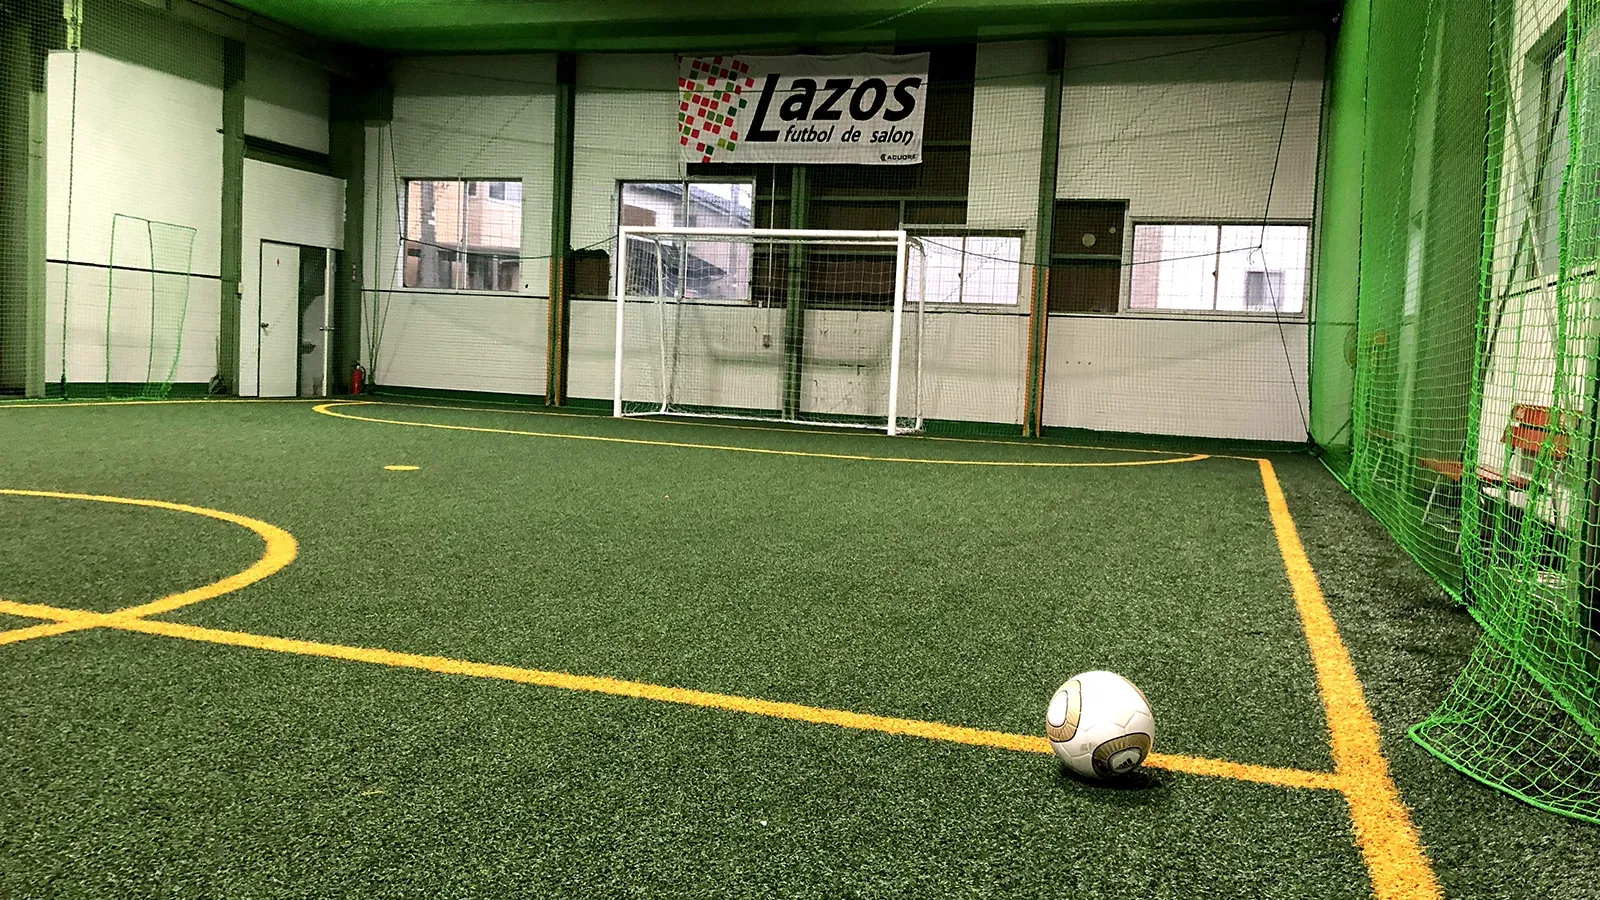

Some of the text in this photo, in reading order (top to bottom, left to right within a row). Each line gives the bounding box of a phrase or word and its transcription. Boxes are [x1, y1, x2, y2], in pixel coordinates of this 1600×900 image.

[744, 73, 923, 142] Lazos
[784, 125, 914, 145] futbol de salon
